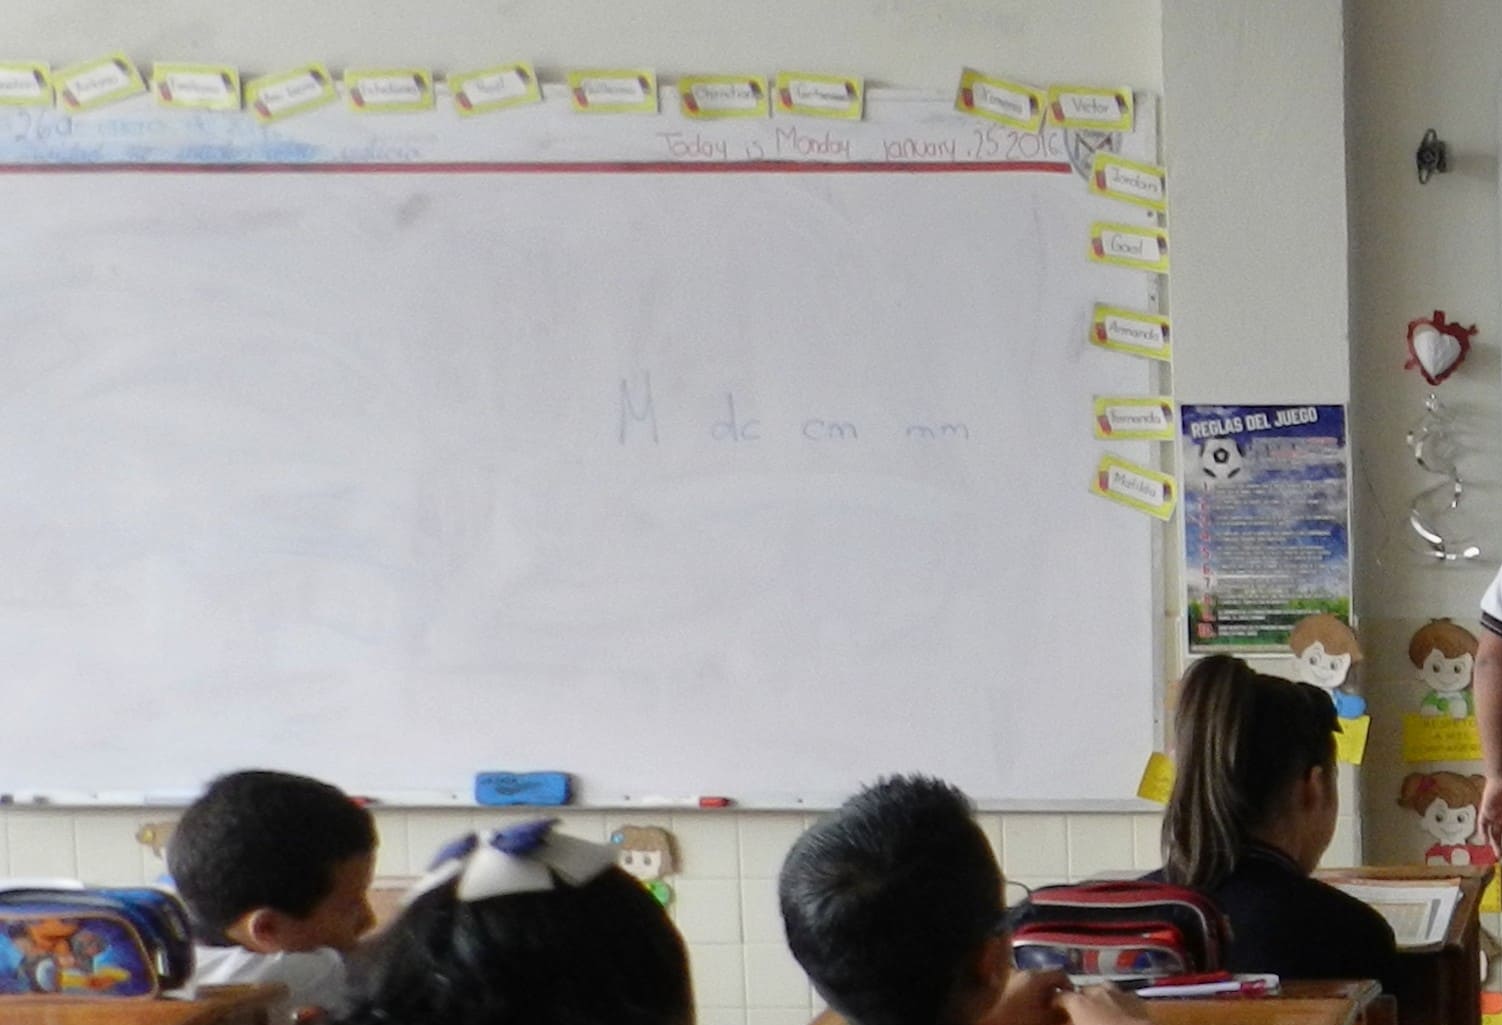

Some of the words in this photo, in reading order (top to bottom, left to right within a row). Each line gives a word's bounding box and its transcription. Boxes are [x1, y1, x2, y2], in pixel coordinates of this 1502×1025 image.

[1070, 96, 1111, 114] Victor
[656, 130, 728, 161] Today
[775, 127, 852, 159] Monday
[1006, 130, 1060, 160] 2016
[617, 368, 659, 445] M
[802, 417, 858, 440] cm
[906, 422, 970, 440] mm
[1190, 416, 1244, 438] REGLAS
[1247, 413, 1272, 431] DEL
[1274, 406, 1318, 427] JUEGO
